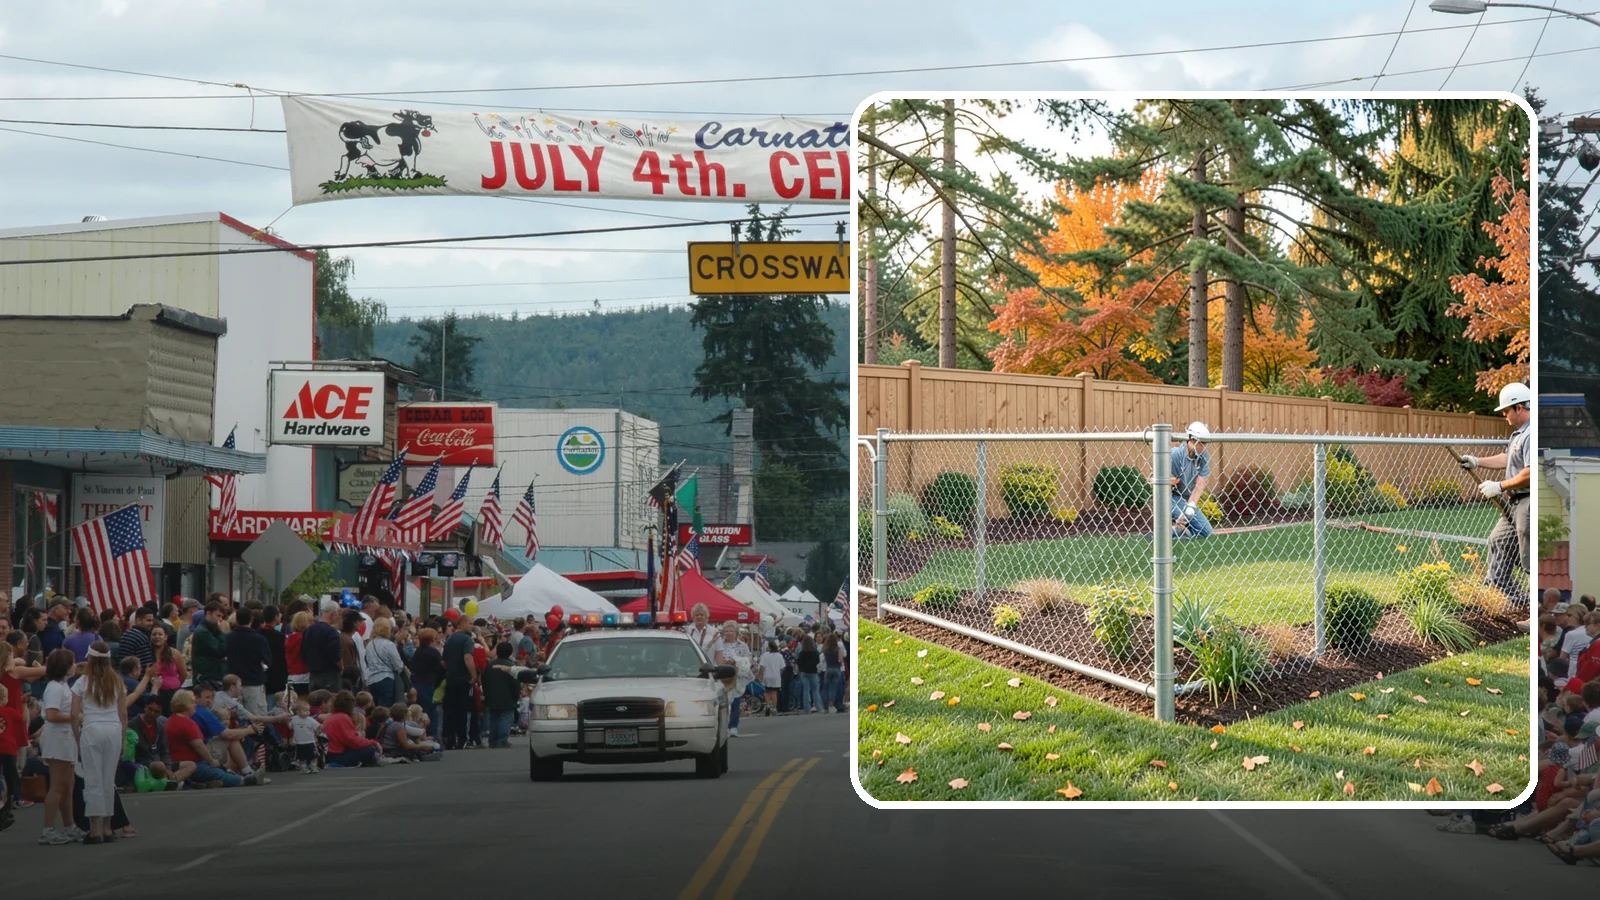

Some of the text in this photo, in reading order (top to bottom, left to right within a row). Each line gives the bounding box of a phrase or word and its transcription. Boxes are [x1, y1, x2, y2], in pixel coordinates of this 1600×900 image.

[481, 141, 604, 192] JULY
[632, 150, 746, 198] 4th.
[697, 254, 850, 280] CROSSWA
[282, 380, 373, 420] ACE
[405, 409, 453, 422] CEDAR
[283, 421, 371, 436] Hardware
[416, 428, 477, 447] Coca-Cola
[83, 485, 155, 495] St. Vincent de Paul
[688, 526, 742, 535] CRNATION
[699, 535, 730, 543] GLASS
